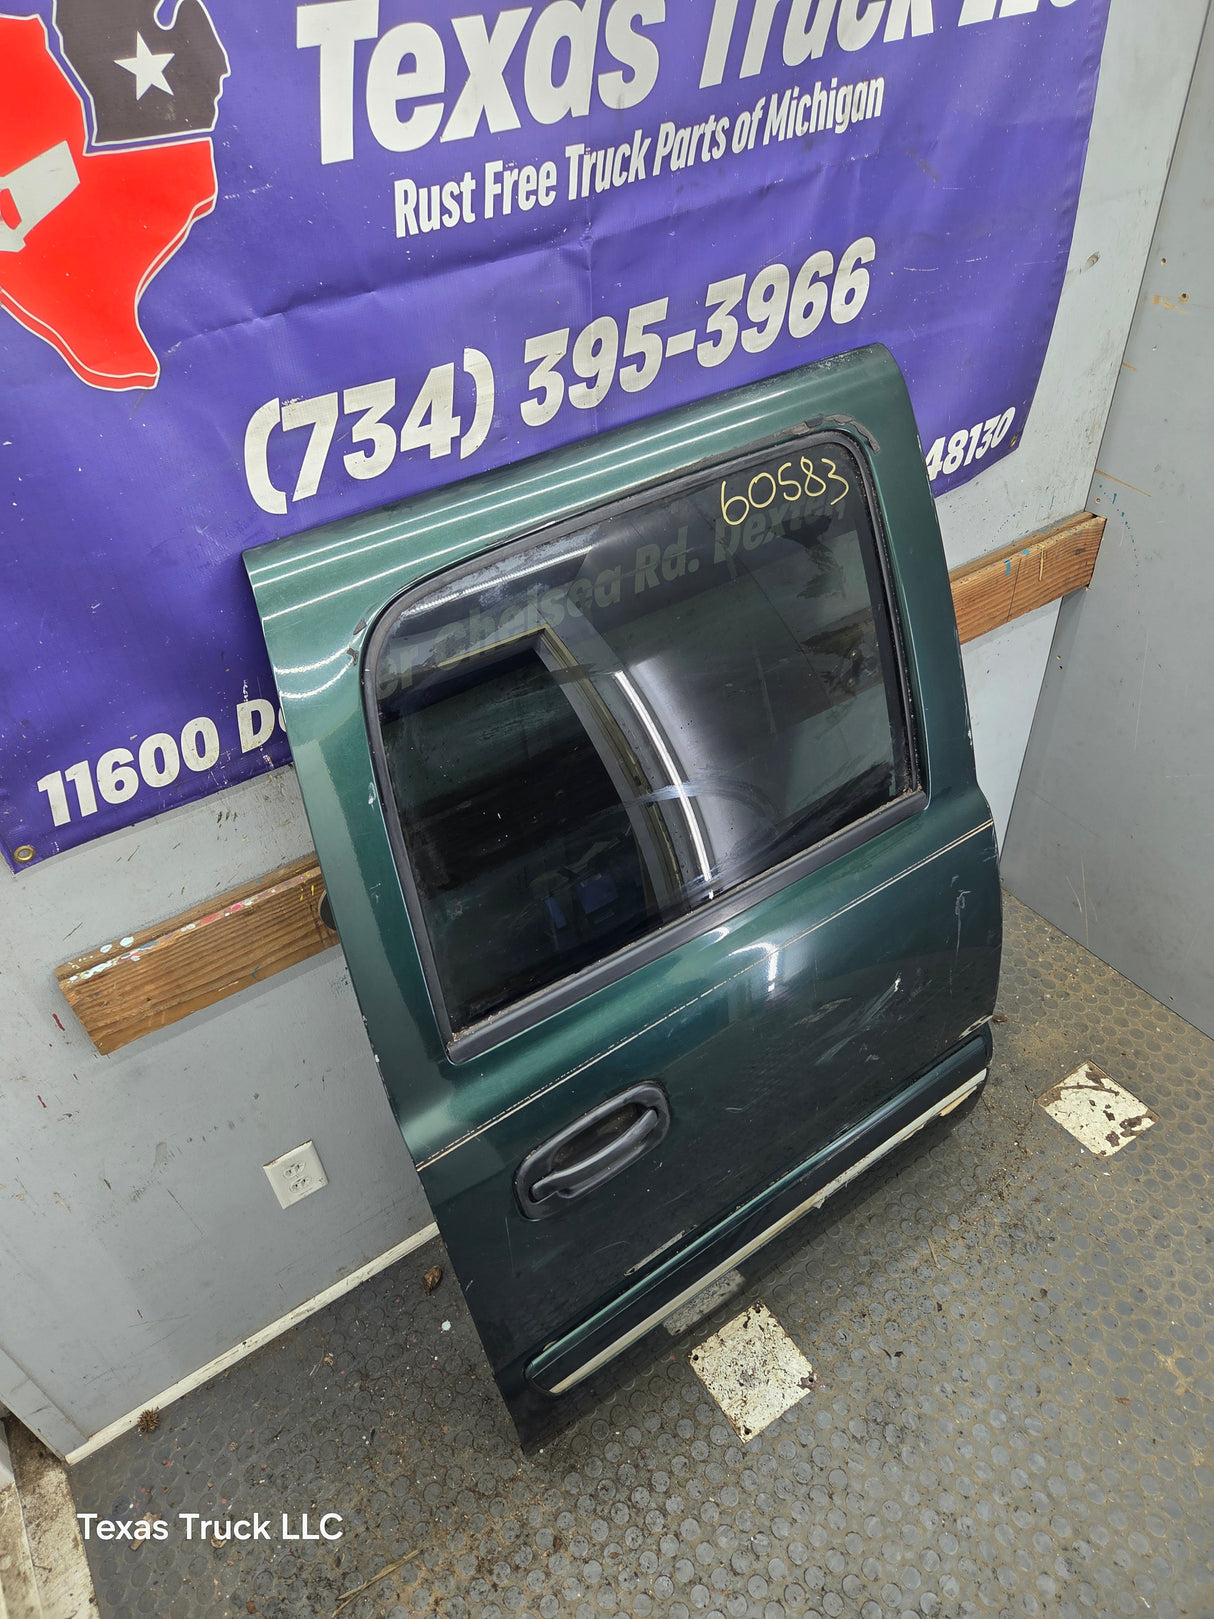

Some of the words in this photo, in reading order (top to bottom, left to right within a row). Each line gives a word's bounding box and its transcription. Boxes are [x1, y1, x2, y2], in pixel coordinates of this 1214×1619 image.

[296, 0, 666, 165] Texas
[394, 171, 476, 239] Rust
[484, 159, 557, 220] Free
[565, 129, 652, 201] Truck
[652, 113, 730, 177] Parts
[731, 96, 766, 154] of
[763, 76, 885, 146] Michigan
[243, 347, 496, 515] (734)
[520, 236, 876, 428] 395-3966
[720, 456, 850, 527] 60583
[37, 716, 220, 827] 11600
[634, 525, 700, 594] Rd.
[925, 406, 1016, 482] 48130
